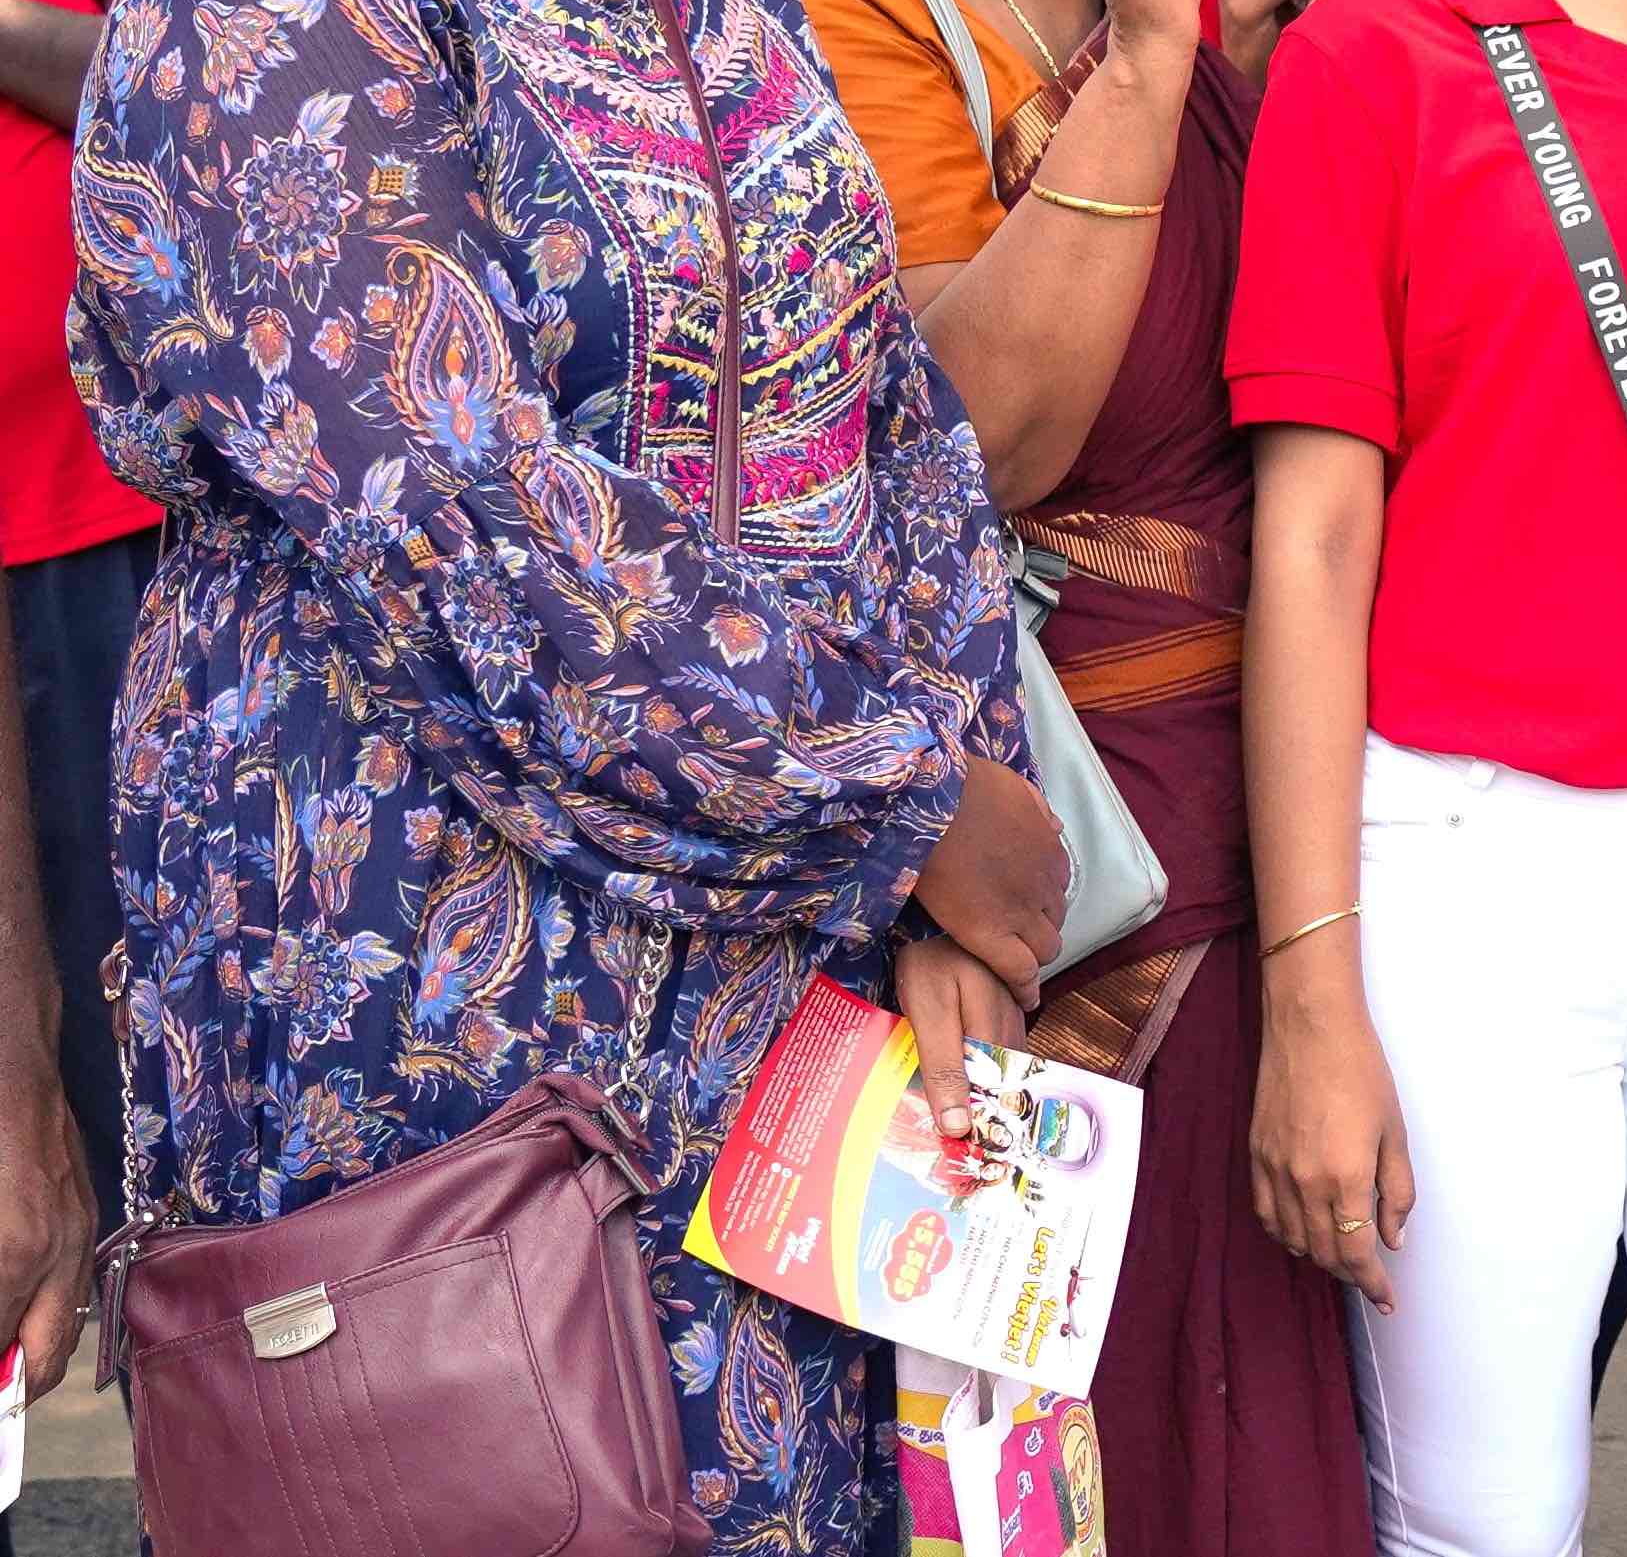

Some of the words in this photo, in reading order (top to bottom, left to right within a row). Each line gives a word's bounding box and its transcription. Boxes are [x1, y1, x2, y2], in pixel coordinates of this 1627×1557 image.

[1526, 121, 1593, 230] YOUNG
[1026, 1226, 1057, 1277] Let's
[1004, 1281, 1042, 1351] Vietjet
